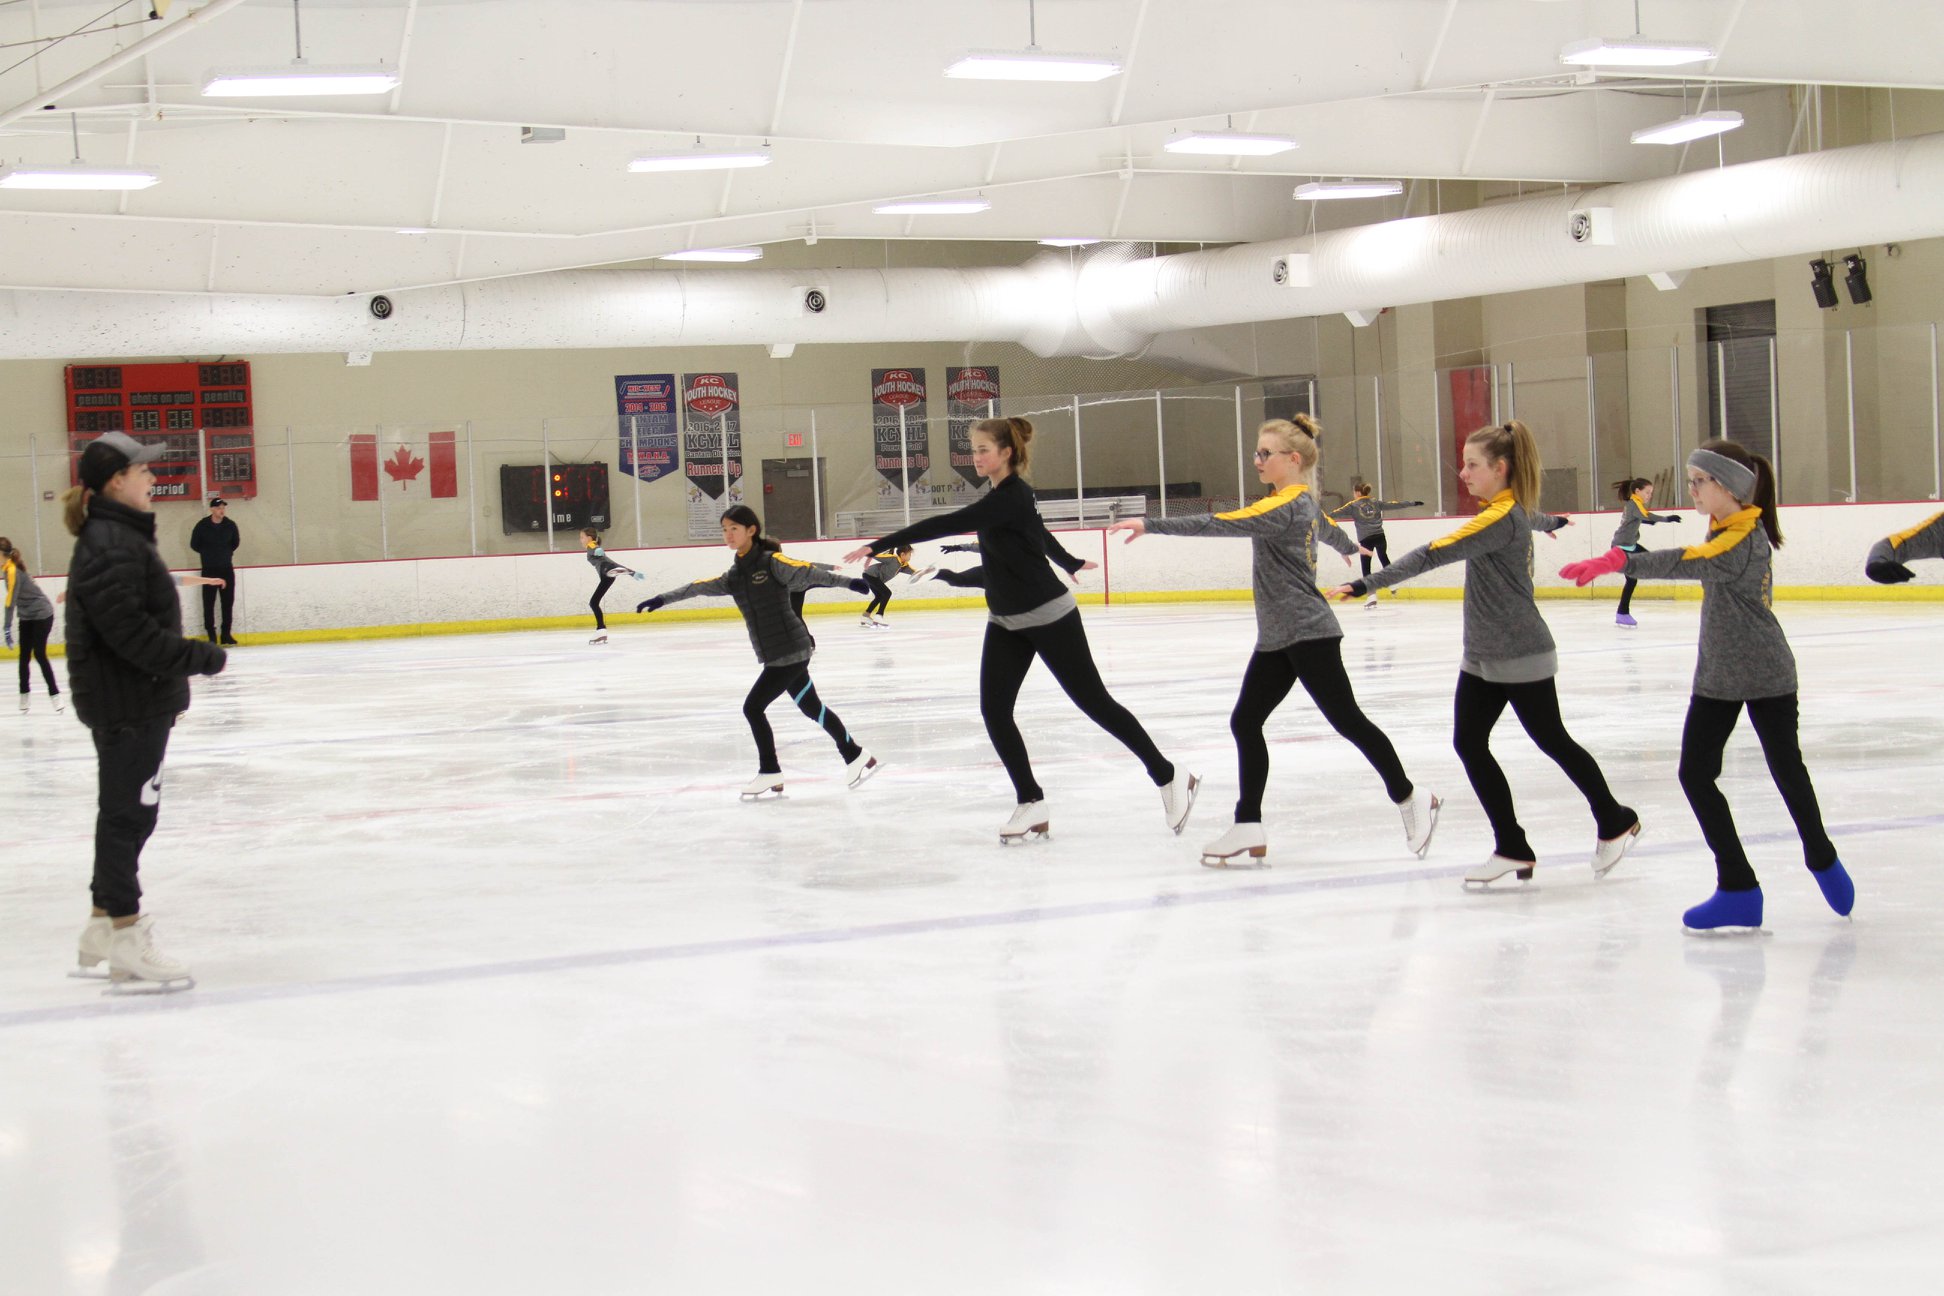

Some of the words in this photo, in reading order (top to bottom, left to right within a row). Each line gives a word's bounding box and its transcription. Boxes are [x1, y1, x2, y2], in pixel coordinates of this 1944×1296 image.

[708, 386, 737, 402] HOCKEY
[874, 382, 896, 398] YOUTH
[897, 381, 925, 398] HOCKEY
[132, 393, 158, 404] shots
[160, 394, 172, 403] on
[204, 390, 244, 403] penalty
[688, 421, 737, 432] 2016-217
[620, 437, 677, 448] CHMPIONS
[712, 449, 741, 457] Divsion
[686, 462, 725, 476] Runners
[728, 460, 742, 477] Up
[876, 455, 914, 469] Runnrs
[915, 454, 928, 470] Up
[151, 483, 185, 496] period
[552, 513, 571, 523] ime
